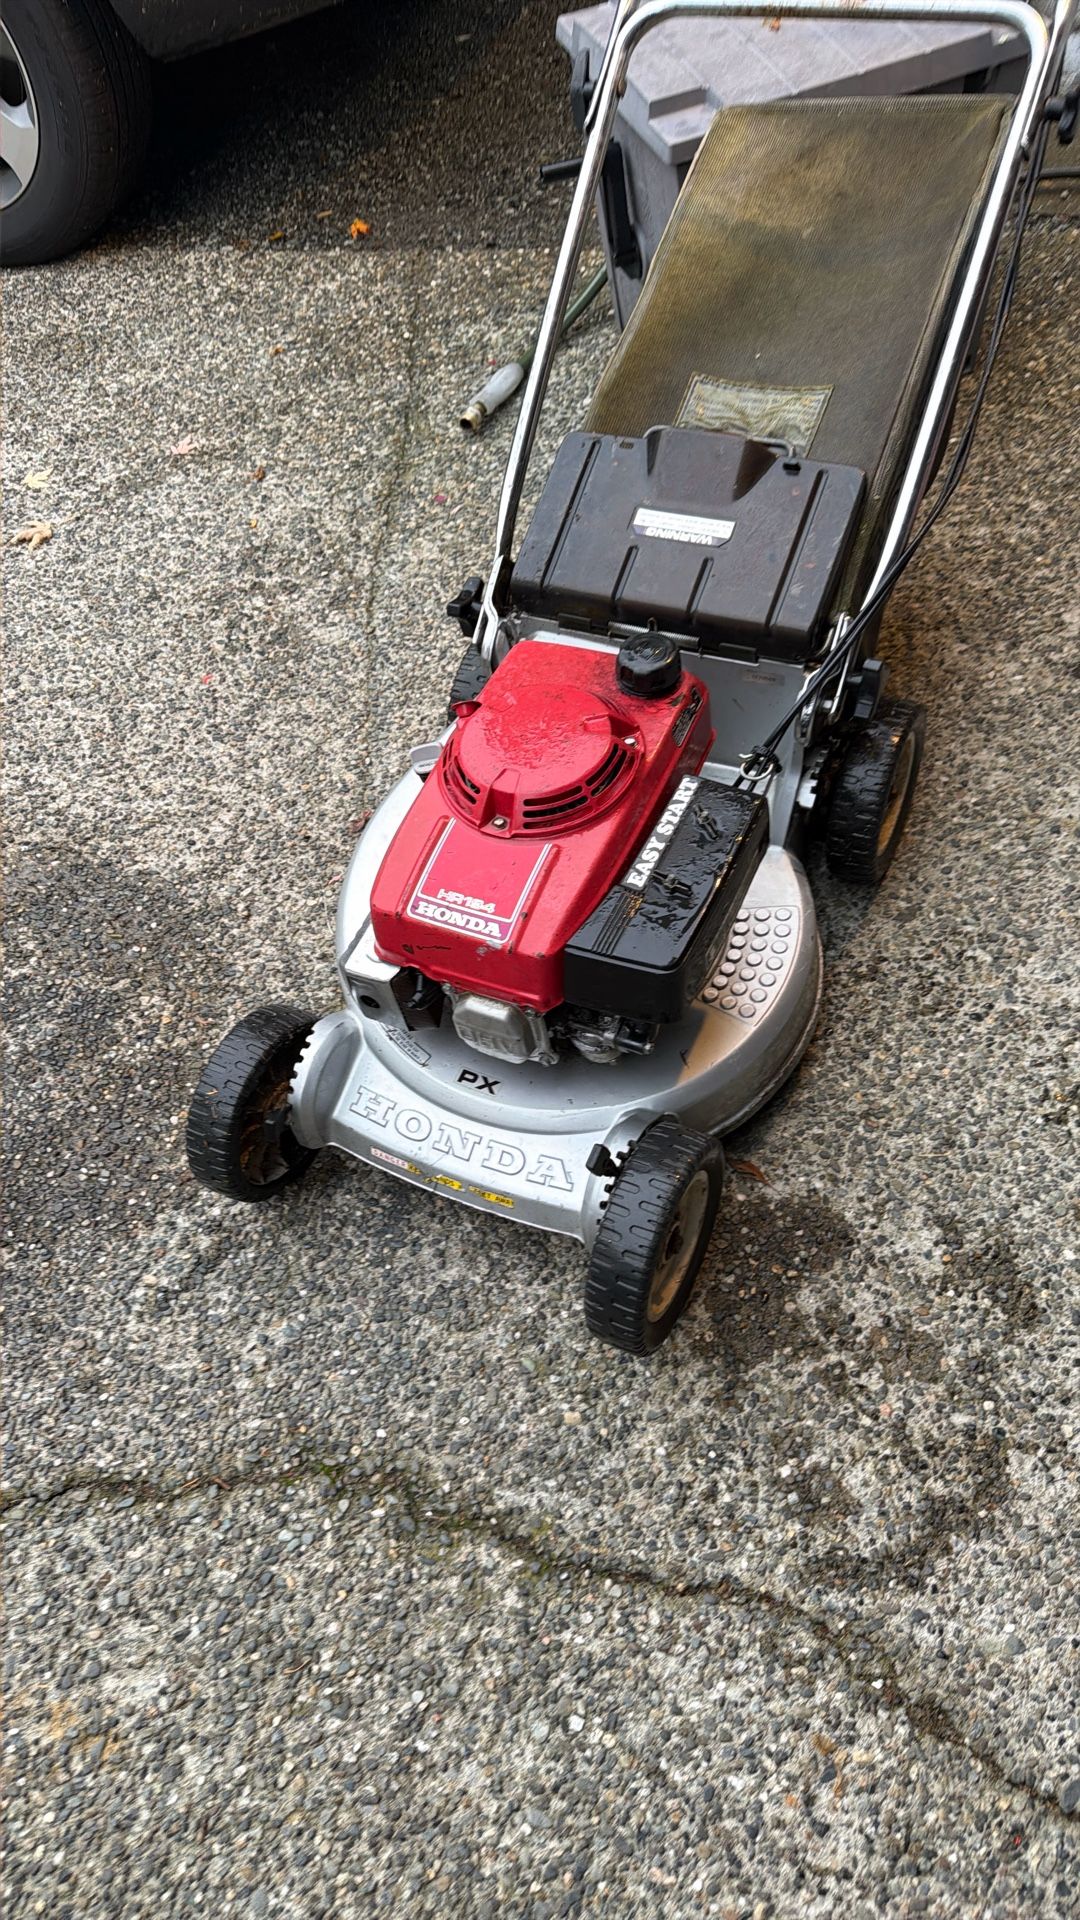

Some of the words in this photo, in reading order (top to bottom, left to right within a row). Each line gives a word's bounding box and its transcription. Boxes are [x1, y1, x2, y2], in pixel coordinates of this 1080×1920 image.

[645, 527, 713, 545] WARNING
[626, 836, 666, 887] EASY
[656, 778, 698, 835] START
[415, 902, 501, 937] HONDA
[457, 1069, 500, 1095] PX
[350, 1085, 574, 1192] HONDA
